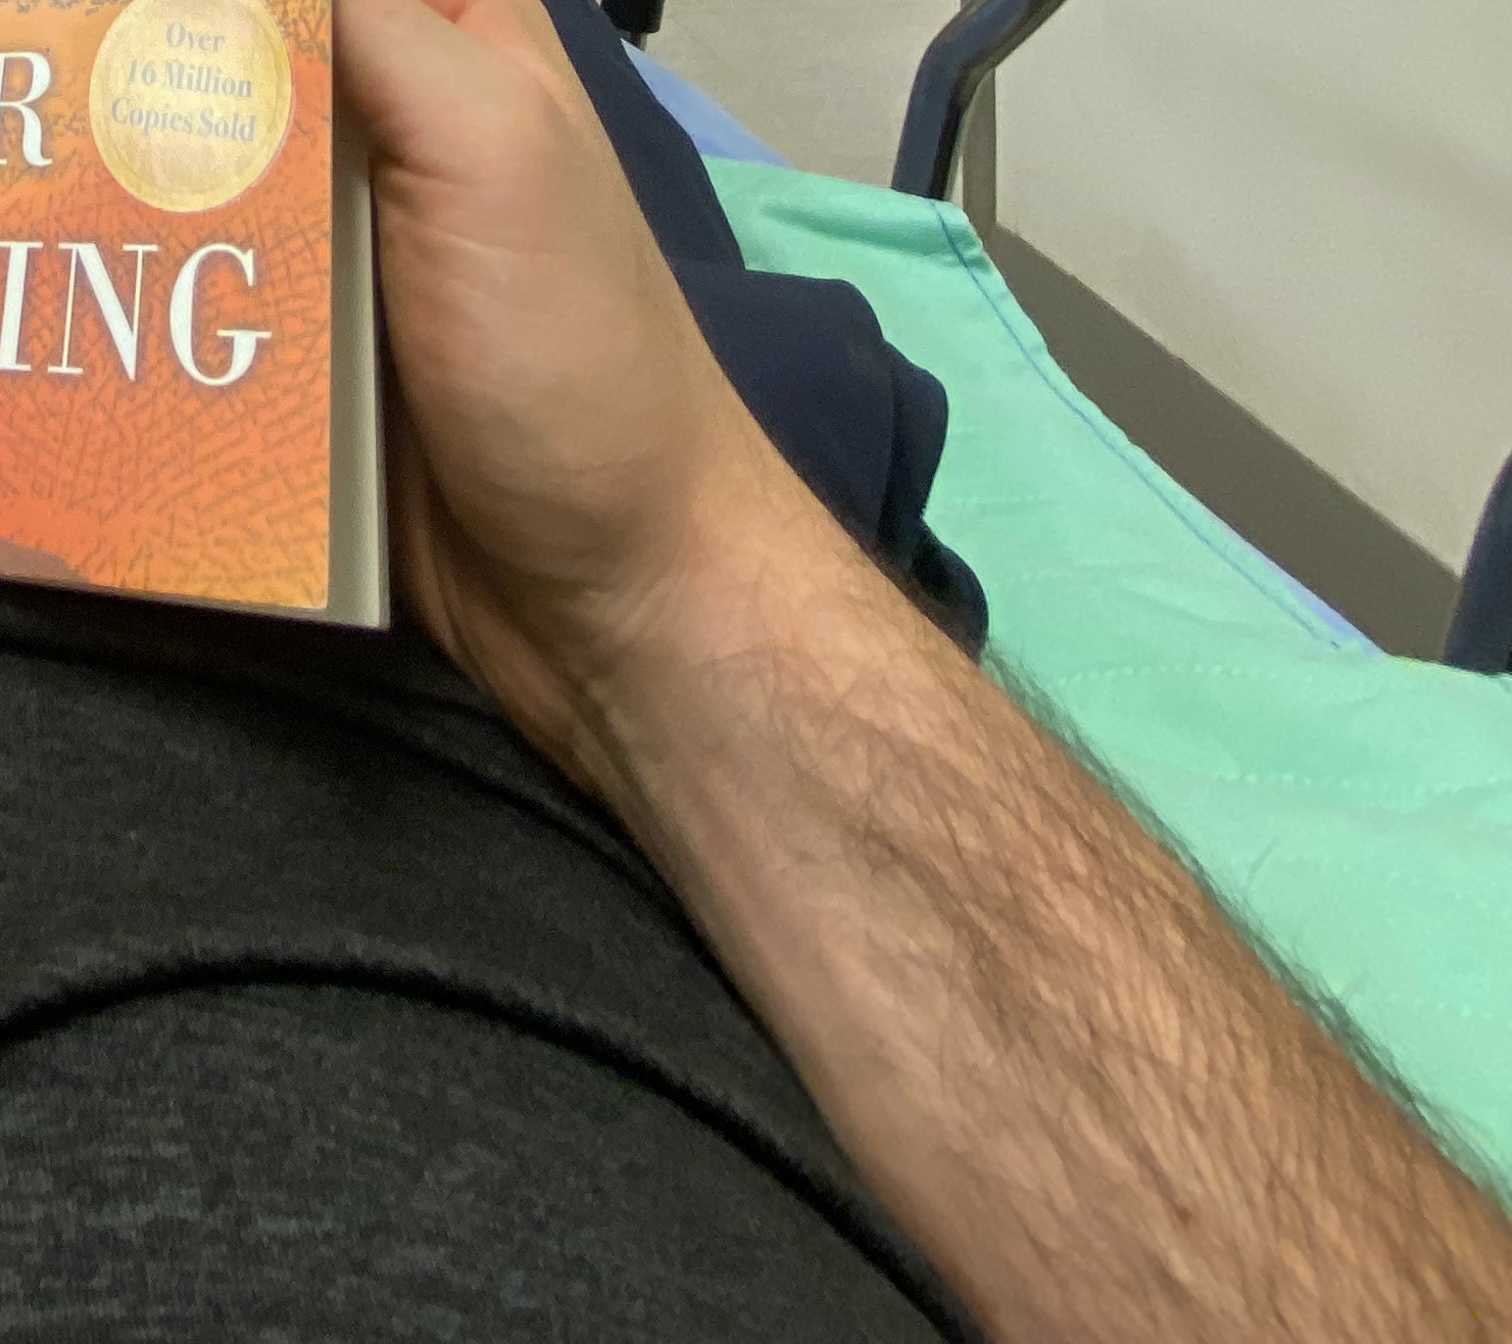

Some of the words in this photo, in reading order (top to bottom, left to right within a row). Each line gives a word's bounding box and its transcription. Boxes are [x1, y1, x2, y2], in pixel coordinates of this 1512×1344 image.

[164, 20, 226, 53] Over
[126, 58, 158, 87] 16
[163, 61, 253, 99] Million
[110, 95, 193, 137] Copies
[198, 107, 257, 143] Sold
